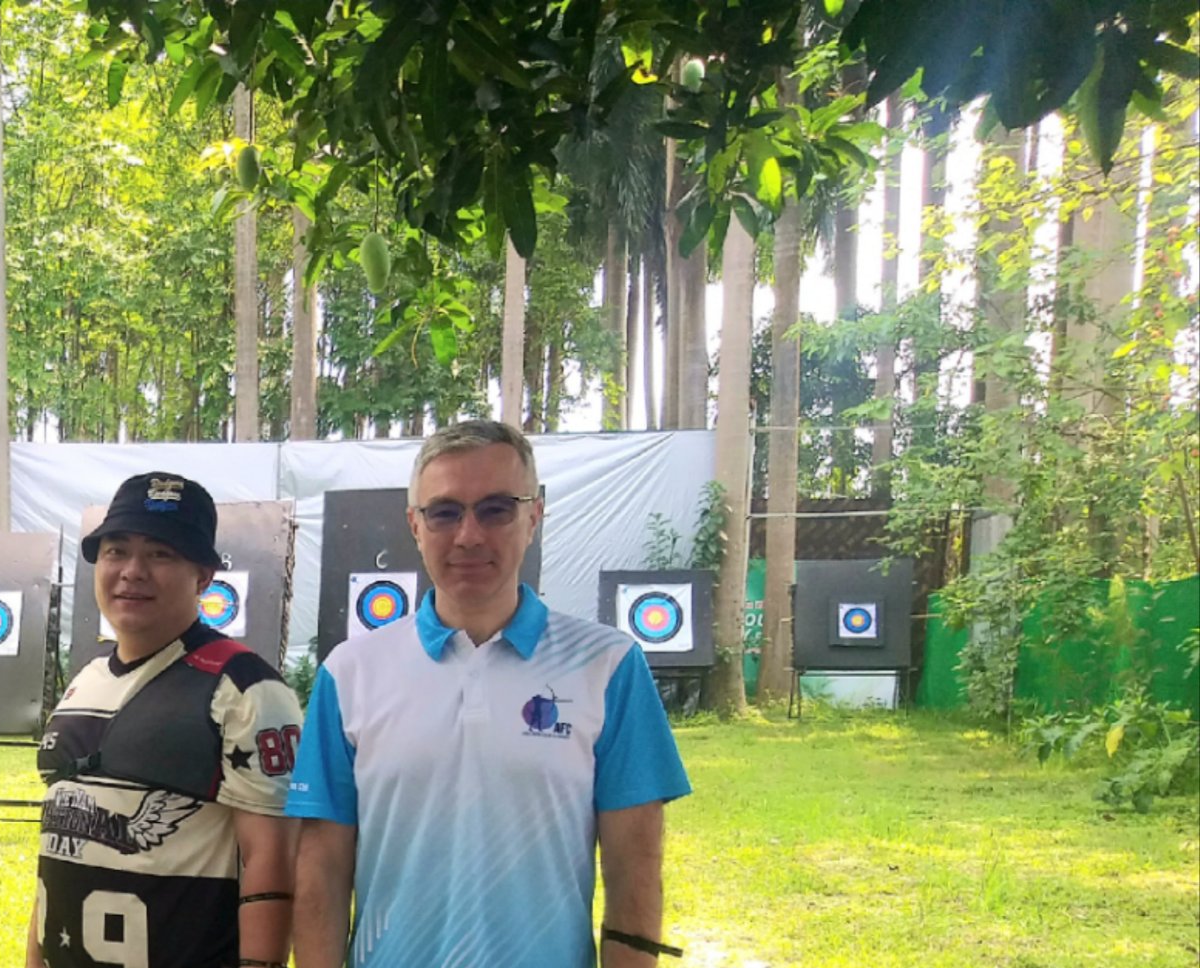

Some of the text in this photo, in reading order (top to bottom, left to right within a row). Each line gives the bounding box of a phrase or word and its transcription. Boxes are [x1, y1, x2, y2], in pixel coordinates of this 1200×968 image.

[375, 549, 388, 569] C
[554, 722, 572, 735] AFC
[46, 833, 88, 858] DAY
